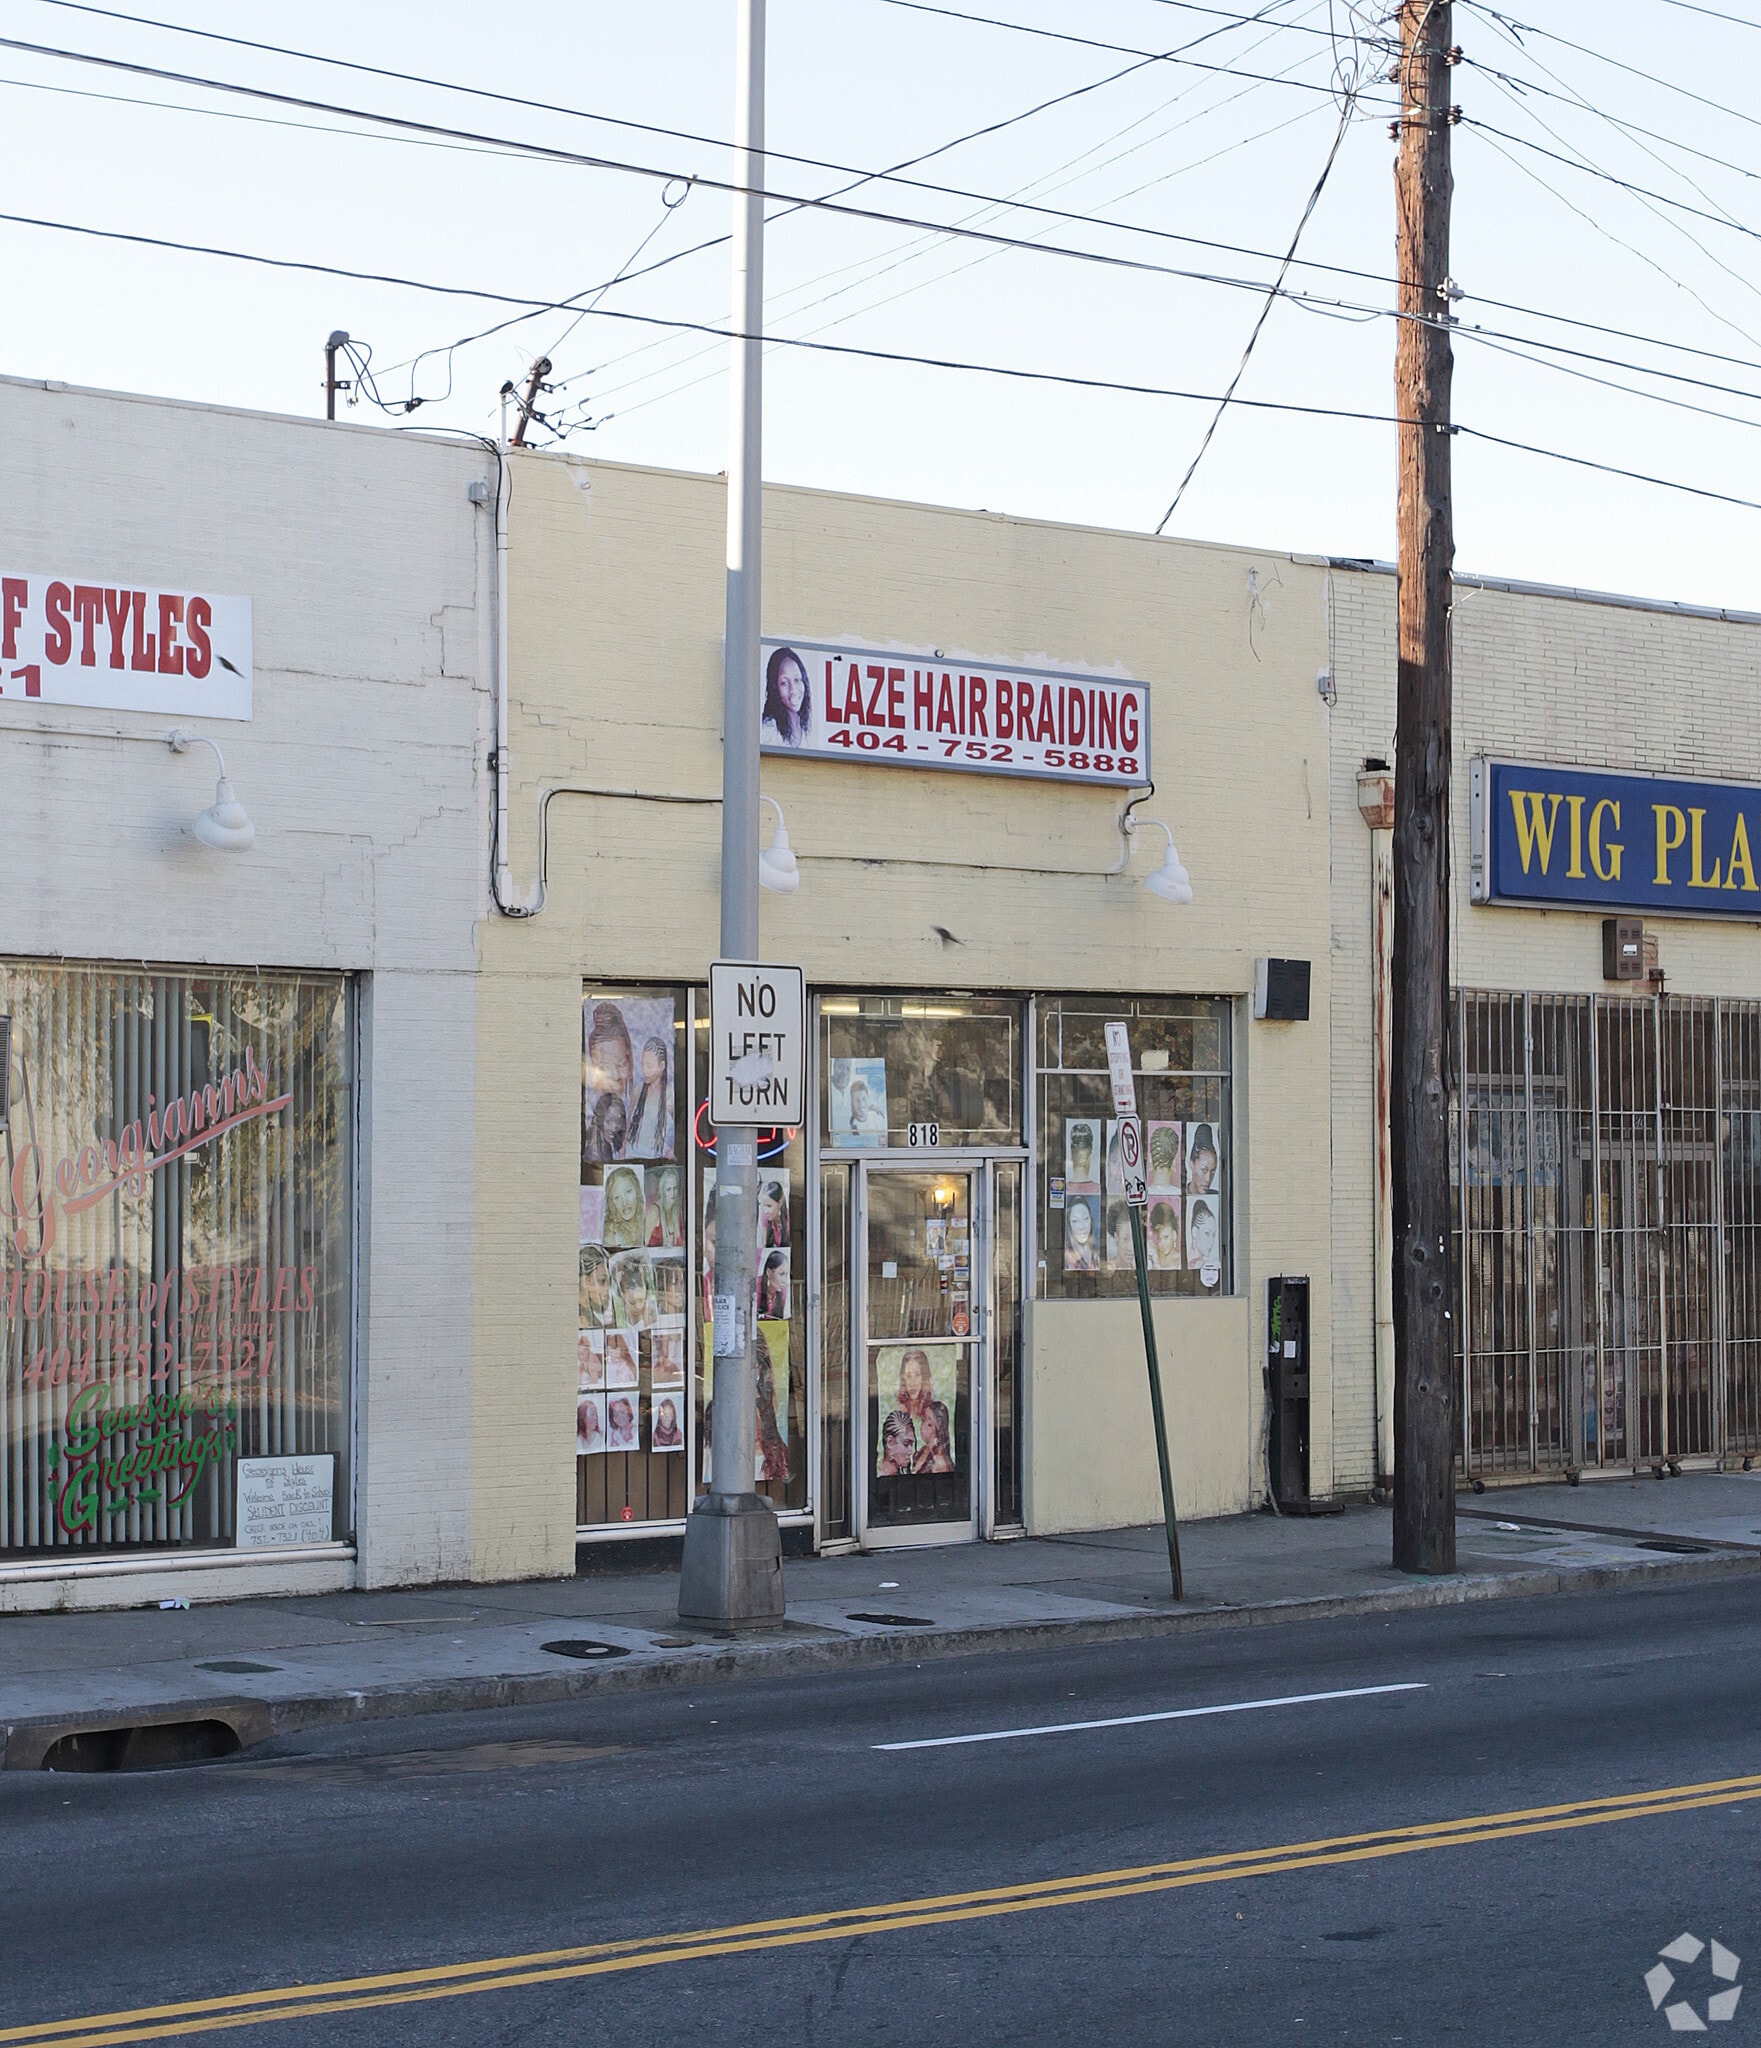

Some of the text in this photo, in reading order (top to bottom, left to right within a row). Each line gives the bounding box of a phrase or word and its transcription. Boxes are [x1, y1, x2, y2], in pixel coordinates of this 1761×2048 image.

[45, 581, 212, 679] STYLES
[0, 664, 41, 698] 1
[825, 660, 1139, 753] LAZE HAIR BRAIDING
[1508, 790, 1760, 892] WIG PLA
[737, 983, 776, 1018] NO
[725, 1077, 788, 1106] TURN
[909, 1124, 938, 1146] 818
[0, 1266, 317, 1328] HOUSE of STYLES
[58, 1321, 88, 1340] The
[169, 1318, 210, 1338] Care
[218, 1318, 276, 1338] Center
[24, 1346, 94, 1385] 404
[59, 1425, 223, 1534] Greetings
